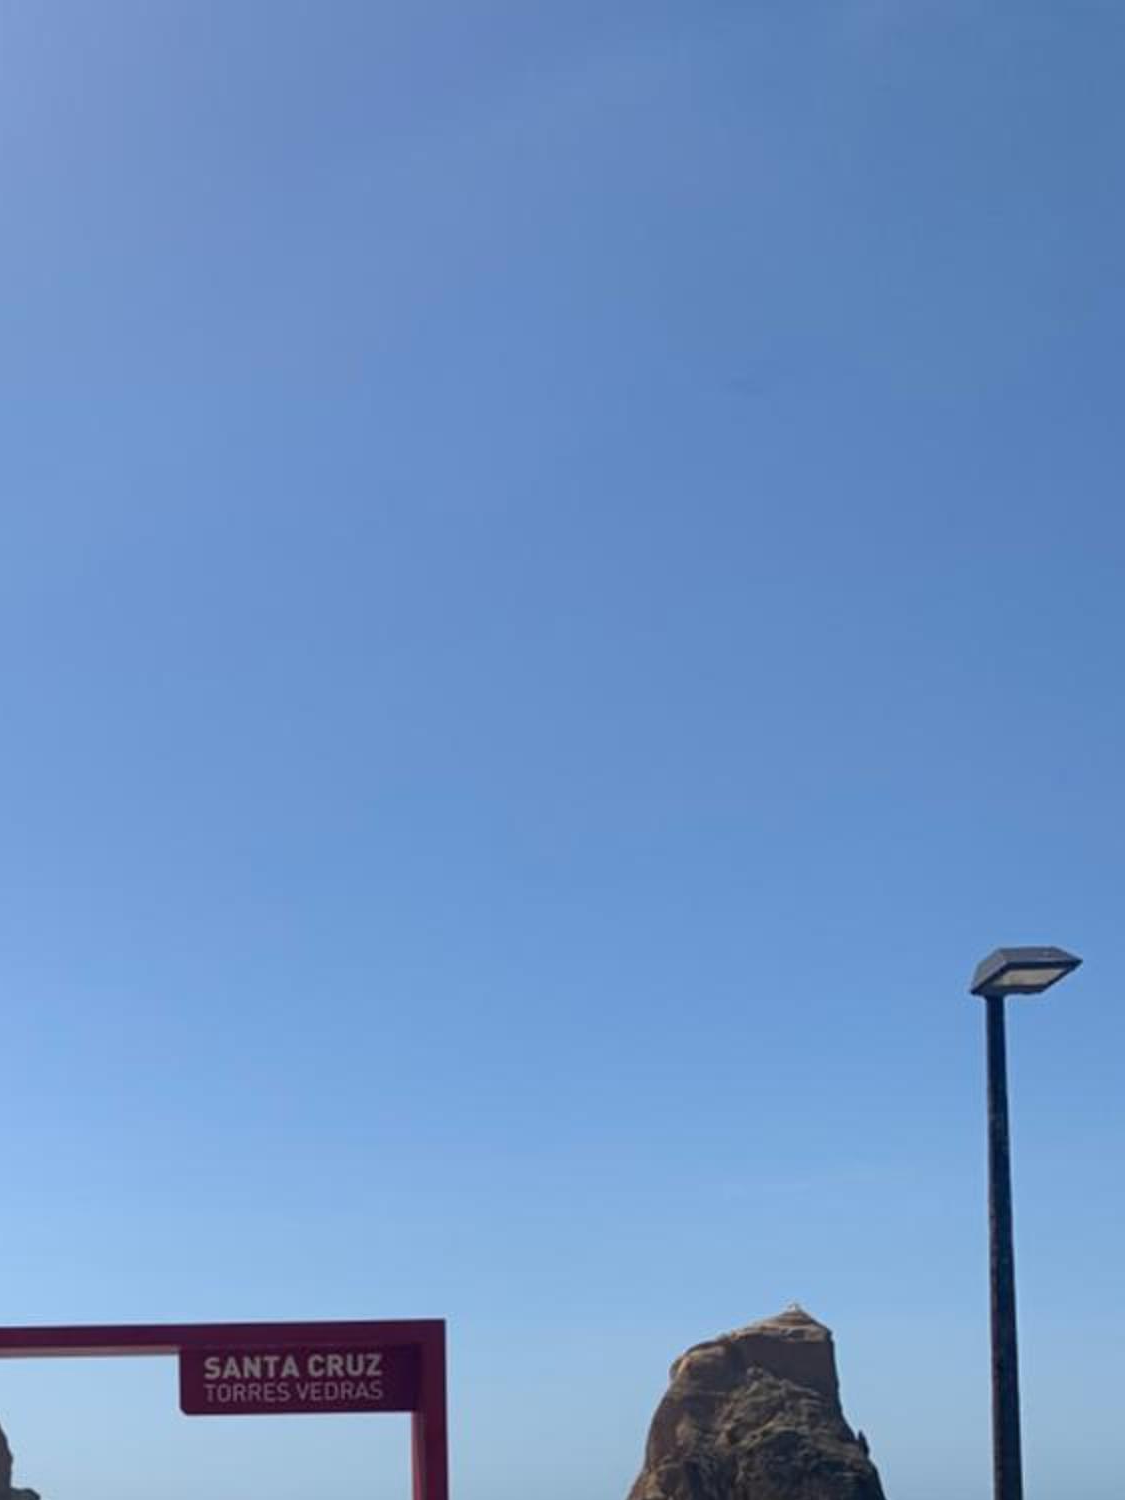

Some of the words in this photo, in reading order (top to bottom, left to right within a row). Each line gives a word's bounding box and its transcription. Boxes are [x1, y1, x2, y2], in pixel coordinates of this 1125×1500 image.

[205, 1355, 299, 1379] SANTA
[308, 1353, 383, 1377] CRUZ
[205, 1382, 290, 1402] TORRES
[296, 1380, 383, 1401] VEDRAS
